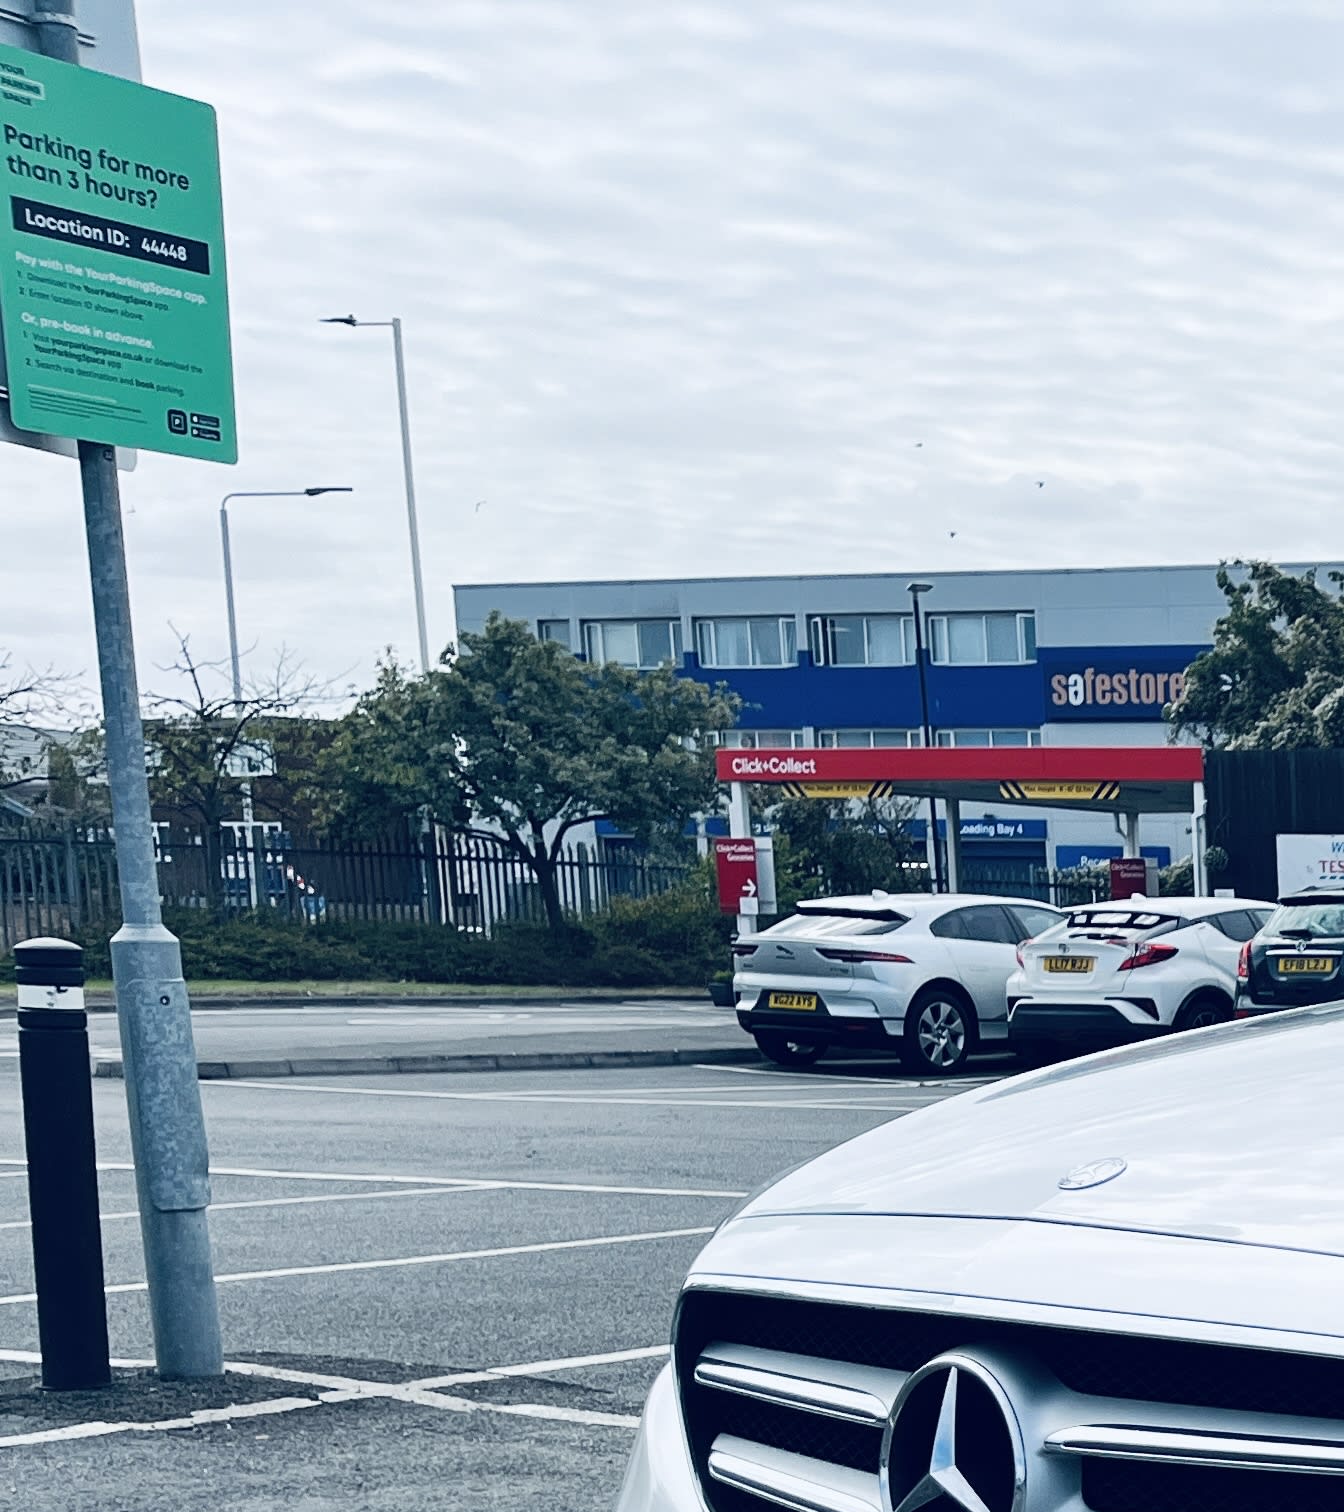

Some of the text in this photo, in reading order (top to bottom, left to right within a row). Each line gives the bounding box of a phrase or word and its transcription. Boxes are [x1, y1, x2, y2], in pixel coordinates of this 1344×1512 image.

[3, 123, 190, 190] Parking for more
[6, 155, 158, 209] than 3 hours?
[25, 208, 188, 262] Location ID: 44448
[15, 251, 37, 268] Pay
[38, 257, 64, 272] with
[64, 263, 83, 276] the
[83, 267, 182, 299] YourParkingSpace
[83, 285, 153, 307] YourParkingSpace
[21, 312, 155, 349] Or, pre-book in advance.
[33, 343, 105, 365] YourParkingSpace
[135, 378, 155, 389] book
[1051, 667, 1186, 706] safestore
[731, 757, 817, 774] Click+Collect
[996, 823, 1015, 837] Bay
[1016, 823, 1023, 834] 4
[716, 844, 754, 853] Click+Collect
